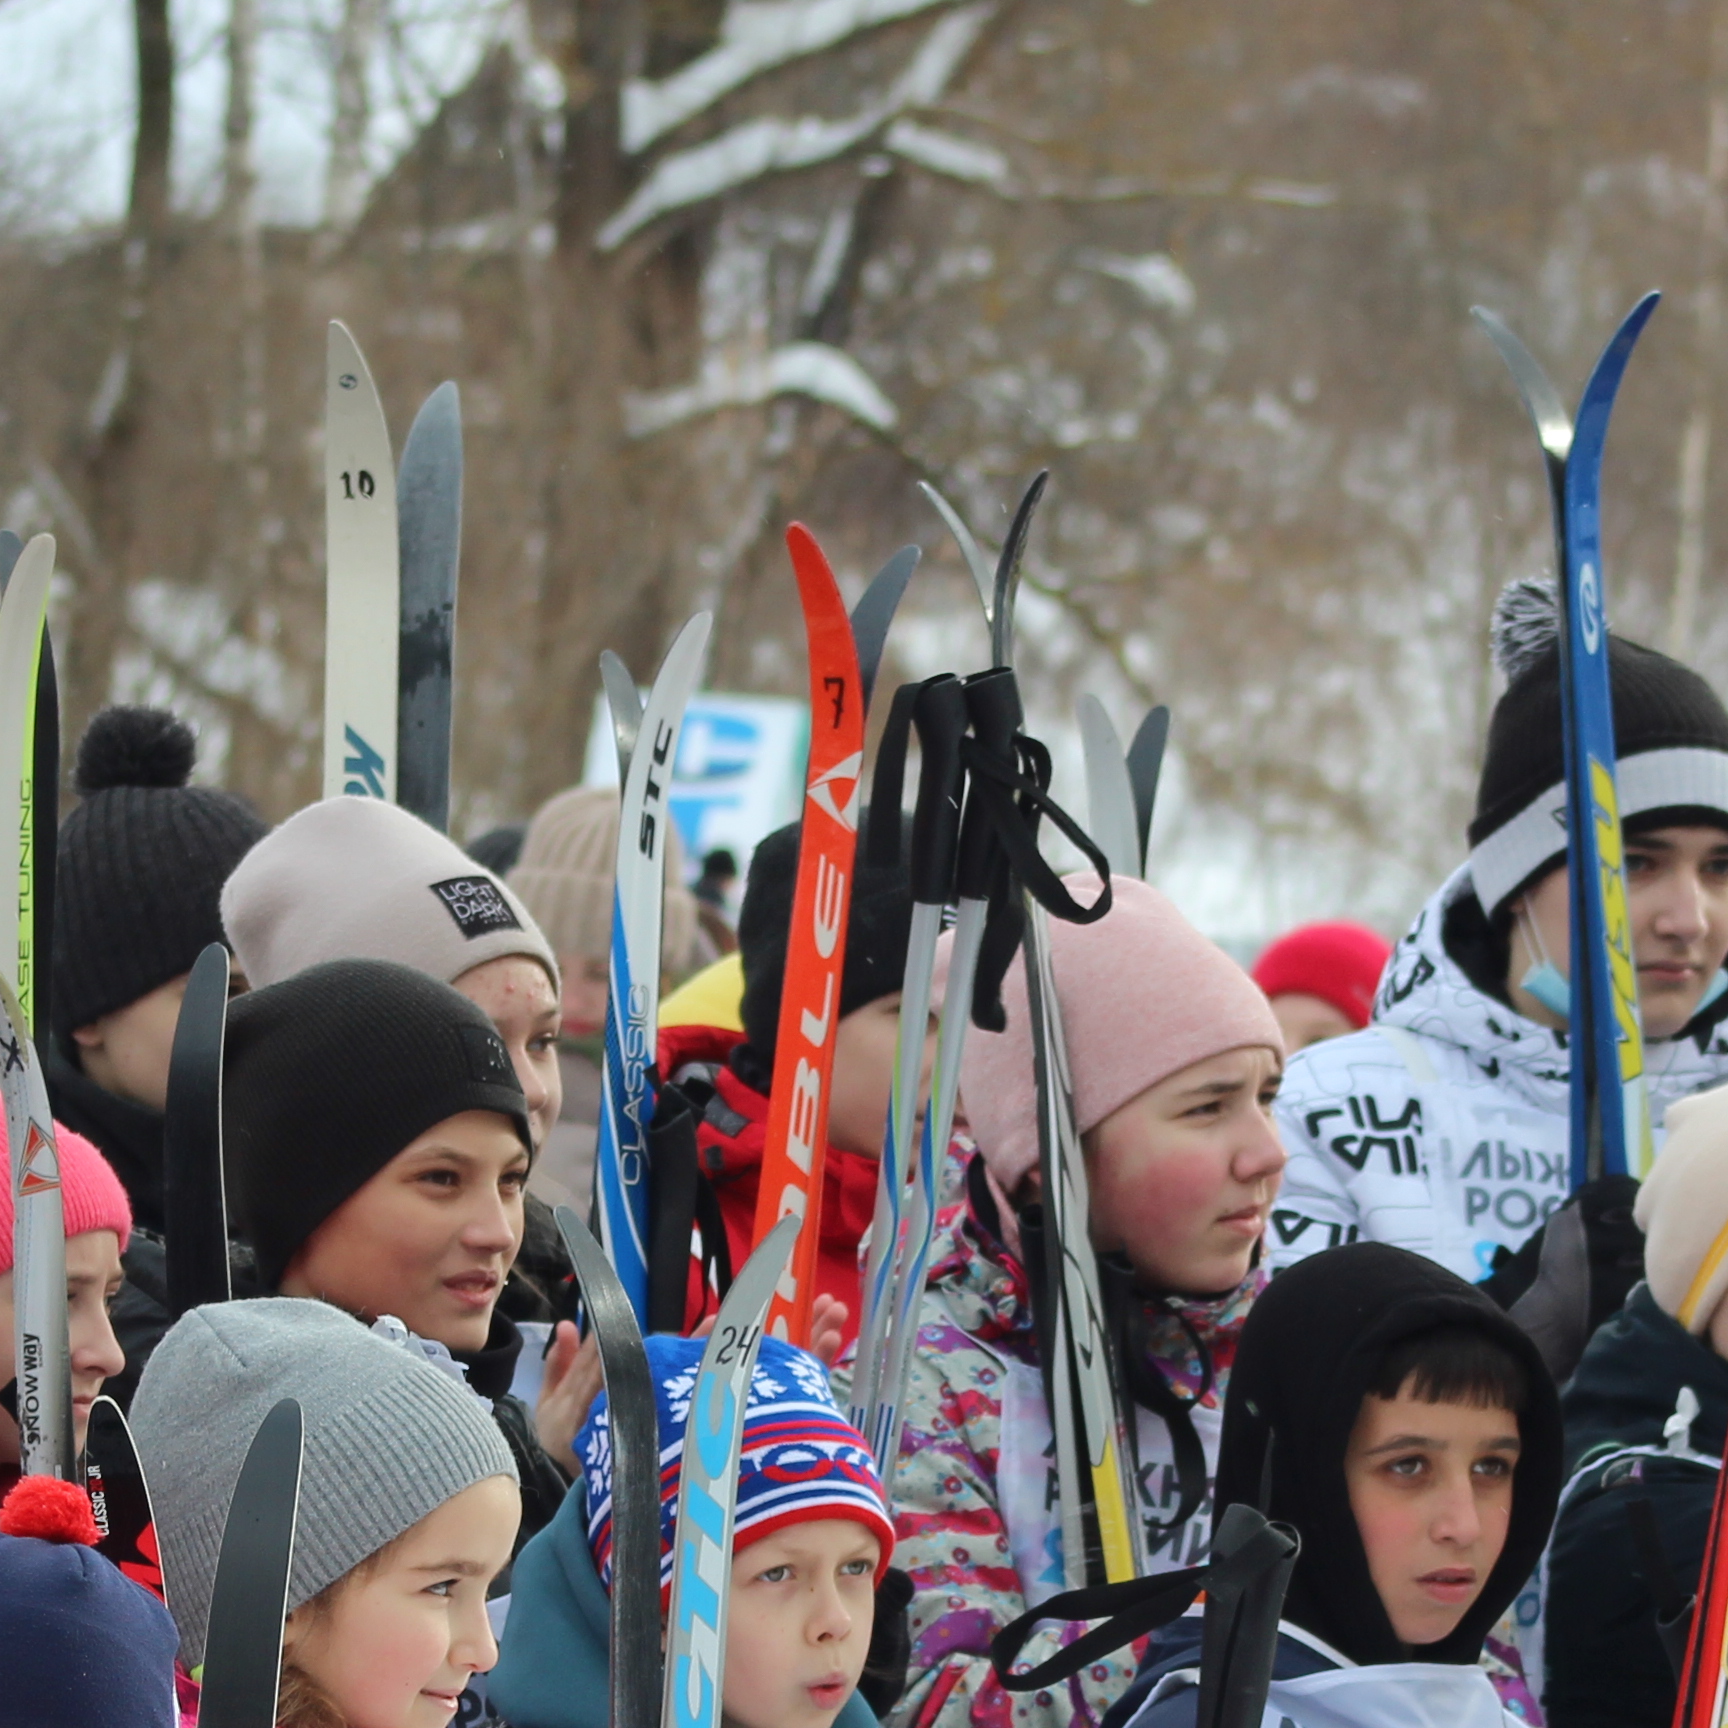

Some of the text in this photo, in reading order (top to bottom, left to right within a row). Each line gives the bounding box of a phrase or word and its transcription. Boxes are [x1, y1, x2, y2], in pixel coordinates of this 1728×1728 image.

[340, 469, 375, 501] 10
[822, 676, 846, 730] 7
[638, 722, 673, 861] STC
[17, 778, 31, 1025] ASE TUNING
[452, 899, 512, 919] DARK
[620, 981, 650, 1187] CLASSIC
[1459, 1139, 1570, 1182] ЛЫЖ
[1465, 1187, 1568, 1229] РОС
[715, 1325, 760, 1368] 24
